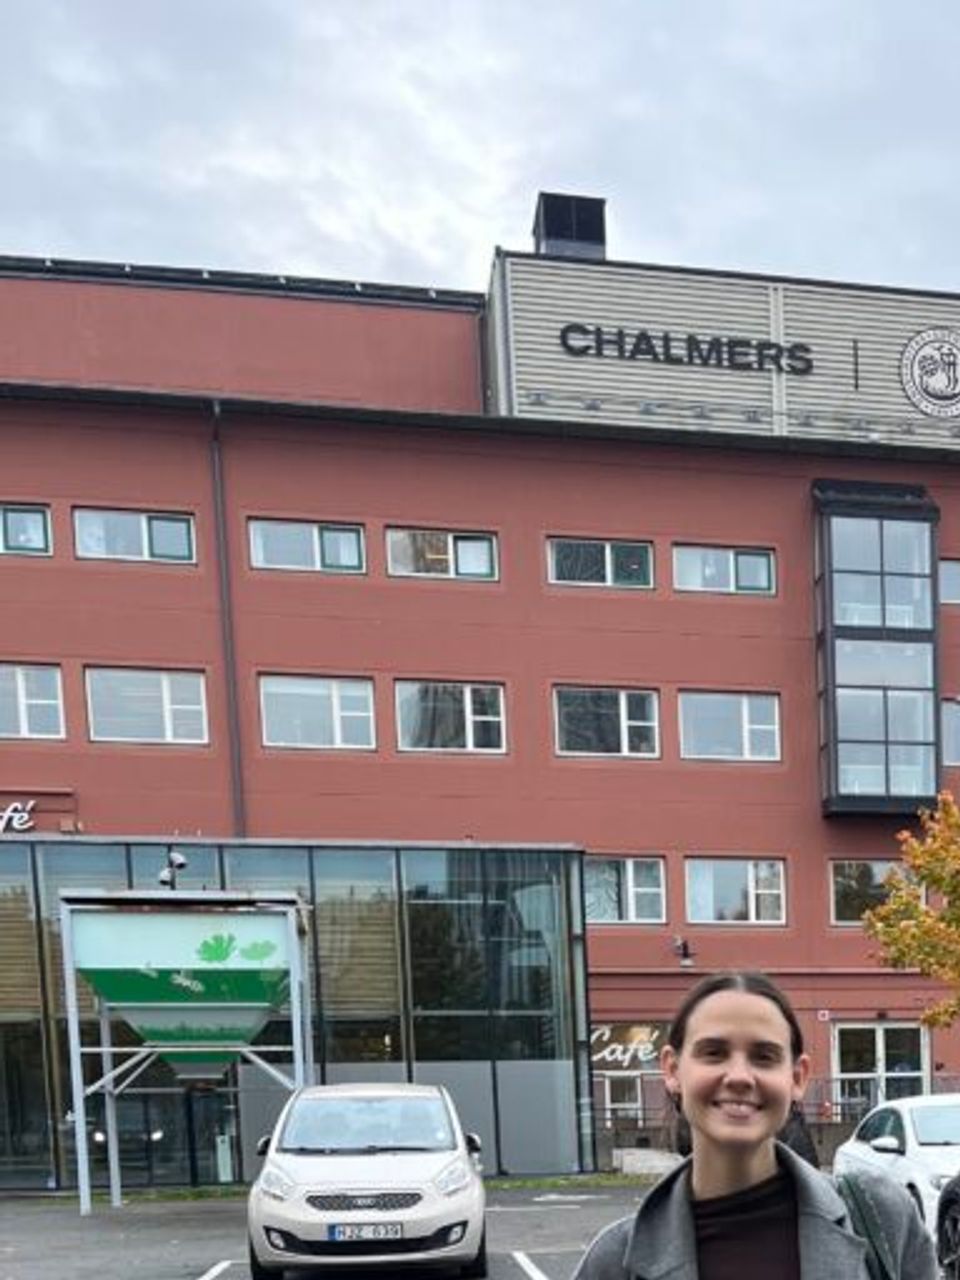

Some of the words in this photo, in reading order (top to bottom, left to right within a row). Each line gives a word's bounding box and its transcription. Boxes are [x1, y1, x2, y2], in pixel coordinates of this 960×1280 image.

[559, 322, 815, 377] CHALMERS
[0, 800, 36, 832] fé
[590, 1026, 660, 1068] Café
